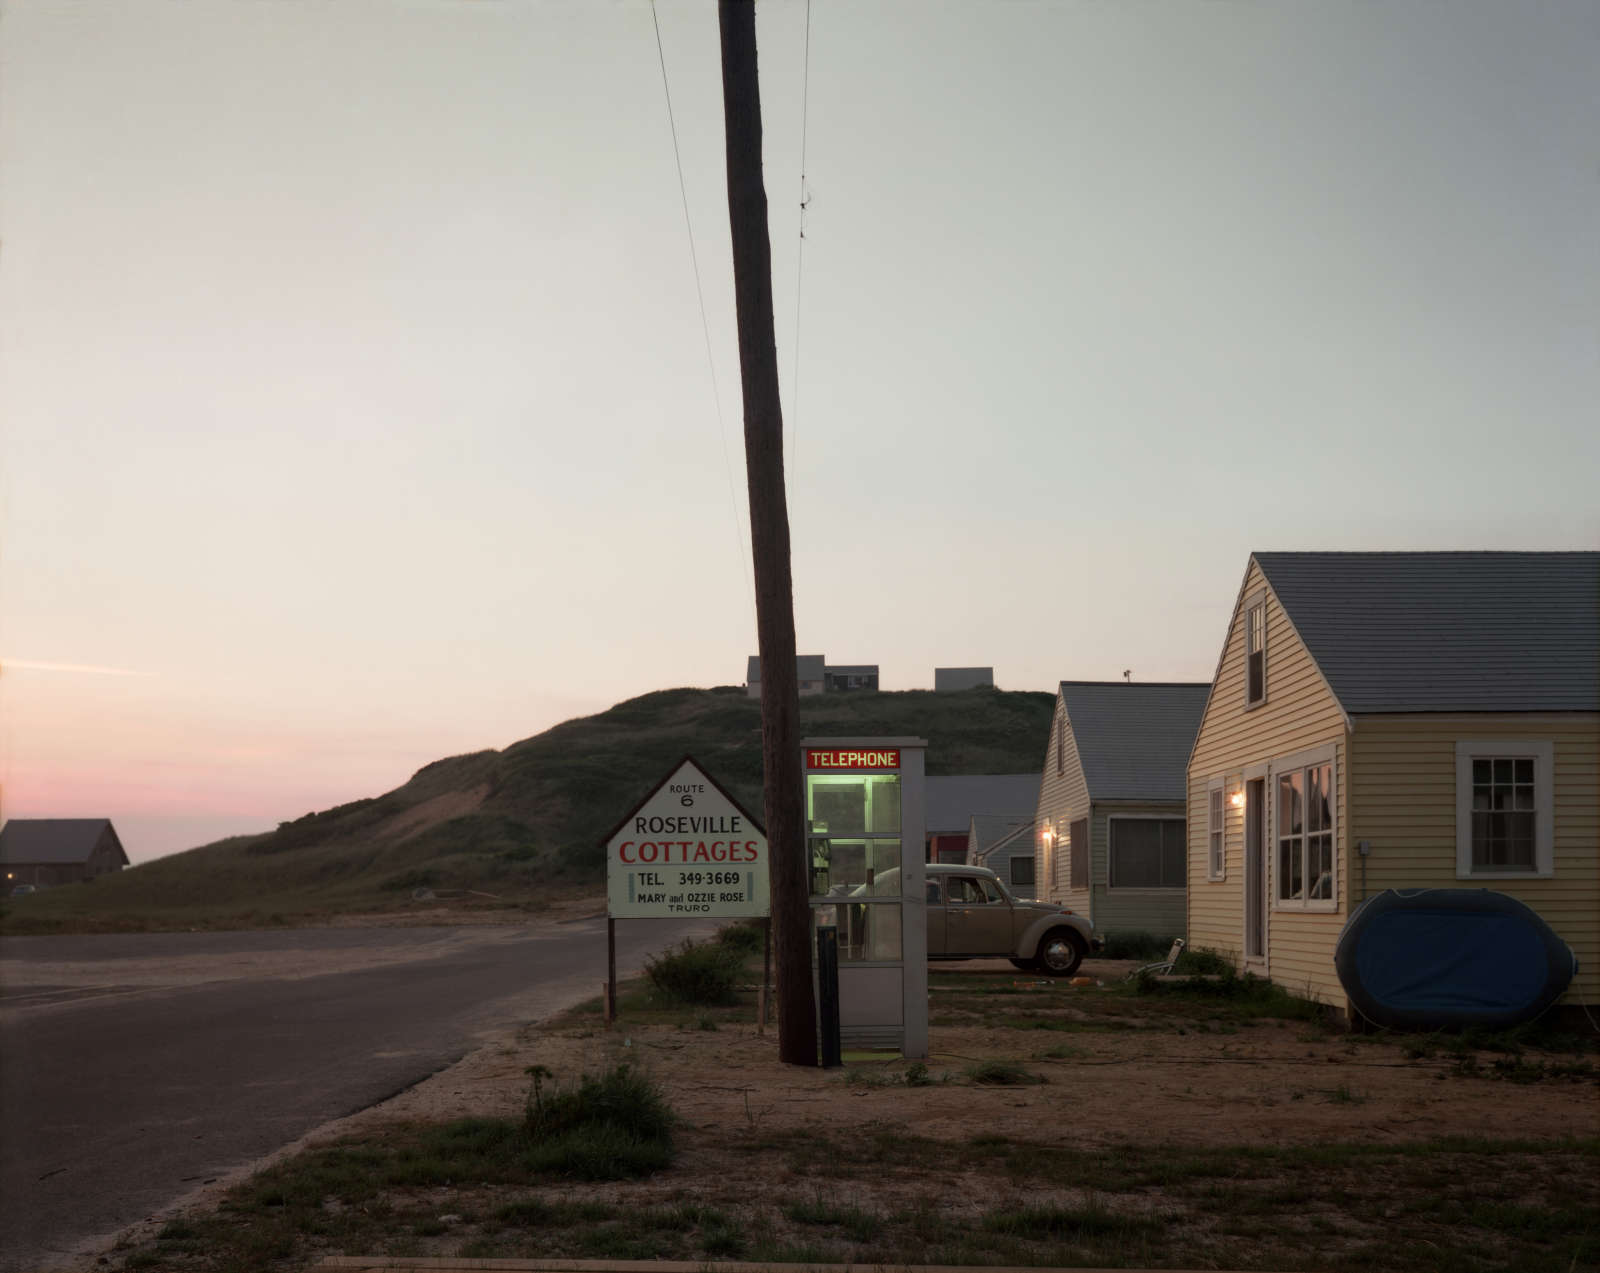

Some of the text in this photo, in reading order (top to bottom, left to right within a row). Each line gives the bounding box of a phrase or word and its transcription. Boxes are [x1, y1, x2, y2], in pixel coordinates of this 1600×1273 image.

[811, 752, 896, 767] TELEPHONE
[670, 785, 705, 793] ROUTE
[681, 795, 694, 807] 6
[636, 817, 742, 833] ROSEVILLE
[619, 841, 758, 863] COTTAGES
[638, 873, 665, 885] TEL.
[638, 893, 744, 903] MARY and OZZIE ROSE
[668, 905, 710, 913] TRURO
